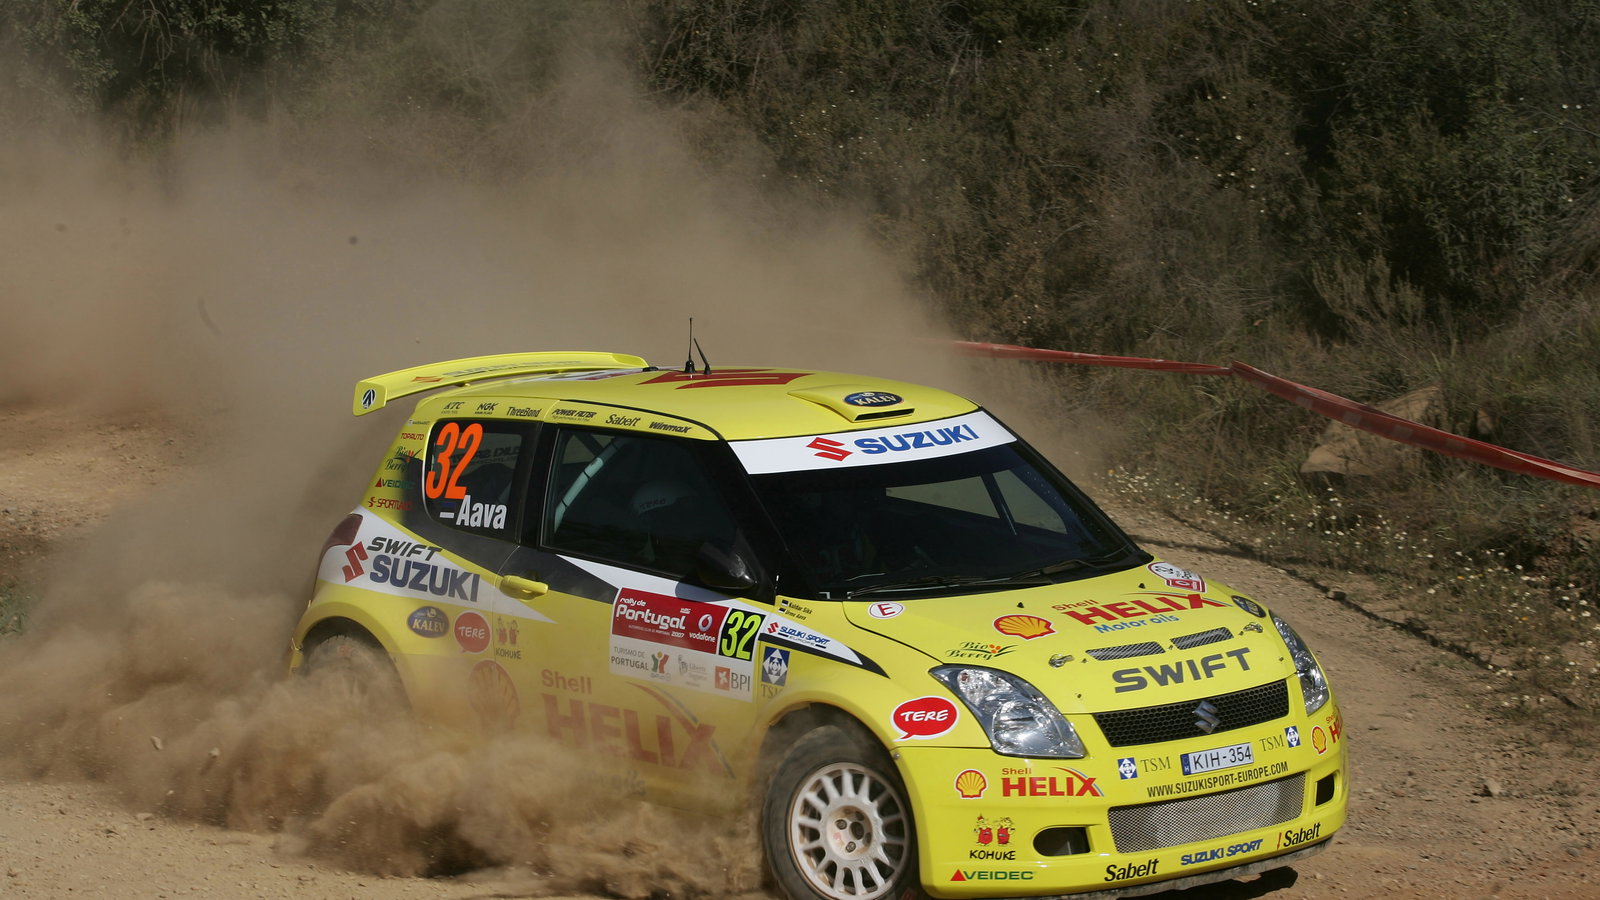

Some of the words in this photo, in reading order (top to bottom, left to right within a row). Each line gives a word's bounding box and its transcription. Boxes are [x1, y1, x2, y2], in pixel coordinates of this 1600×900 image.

[444, 402, 465, 410] KTC
[477, 402, 498, 411] NGK
[854, 394, 898, 406] KALEV
[506, 406, 542, 417] ThreeBond
[552, 408, 576, 416] POWER
[574, 410, 597, 418] FILTER
[605, 414, 641, 427] Sabelt
[648, 421, 692, 434] Winmax
[401, 433, 424, 441] TOPAUTO
[854, 424, 980, 455] SUZUKI
[426, 422, 483, 500] 32
[382, 480, 415, 489] VEID
[377, 498, 413, 510] SPORTL
[455, 495, 507, 530] Aava
[367, 536, 443, 561] SWIFT
[369, 554, 480, 602] SUZUKI
[619, 597, 637, 606] rally
[1051, 599, 1099, 611] Shell
[616, 604, 686, 630] Portugal
[877, 603, 896, 616] E
[1061, 593, 1228, 626] HELIX
[412, 618, 445, 633] KALEV
[1093, 617, 1147, 634] Motor
[1150, 614, 1179, 624] oils
[458, 626, 485, 640] TERE
[689, 632, 716, 643] vodafone
[721, 611, 761, 660] 32
[779, 625, 806, 639] SUZUKI
[805, 634, 830, 645] SPORT
[495, 647, 522, 660] KOHUKE
[614, 646, 637, 656] TURISMO
[637, 650, 646, 658] DE
[960, 641, 989, 651] Bio
[611, 656, 650, 671] PORTUGAL
[945, 650, 993, 662] Berry
[1112, 647, 1251, 693] SWIFT
[541, 668, 593, 695] Shell
[731, 672, 751, 692] BPI
[900, 709, 949, 723] TERE
[541, 693, 722, 778] HELIX
[1259, 734, 1285, 752] TSM
[1141, 756, 1172, 773] TSM
[1193, 746, 1252, 771] KIH-354
[1001, 767, 1032, 776] Shell
[1001, 777, 1101, 797] HELIX
[1147, 761, 1289, 798] WWW.SUZUKISPORT-EUROPE.COM
[1283, 822, 1321, 847] Sabelt
[969, 849, 1016, 860] KOHUKE
[1181, 846, 1224, 867] SUZUKI
[1226, 839, 1263, 859] SPORT
[964, 870, 1034, 881] VEIDEC
[1104, 858, 1159, 882] Sabelt
